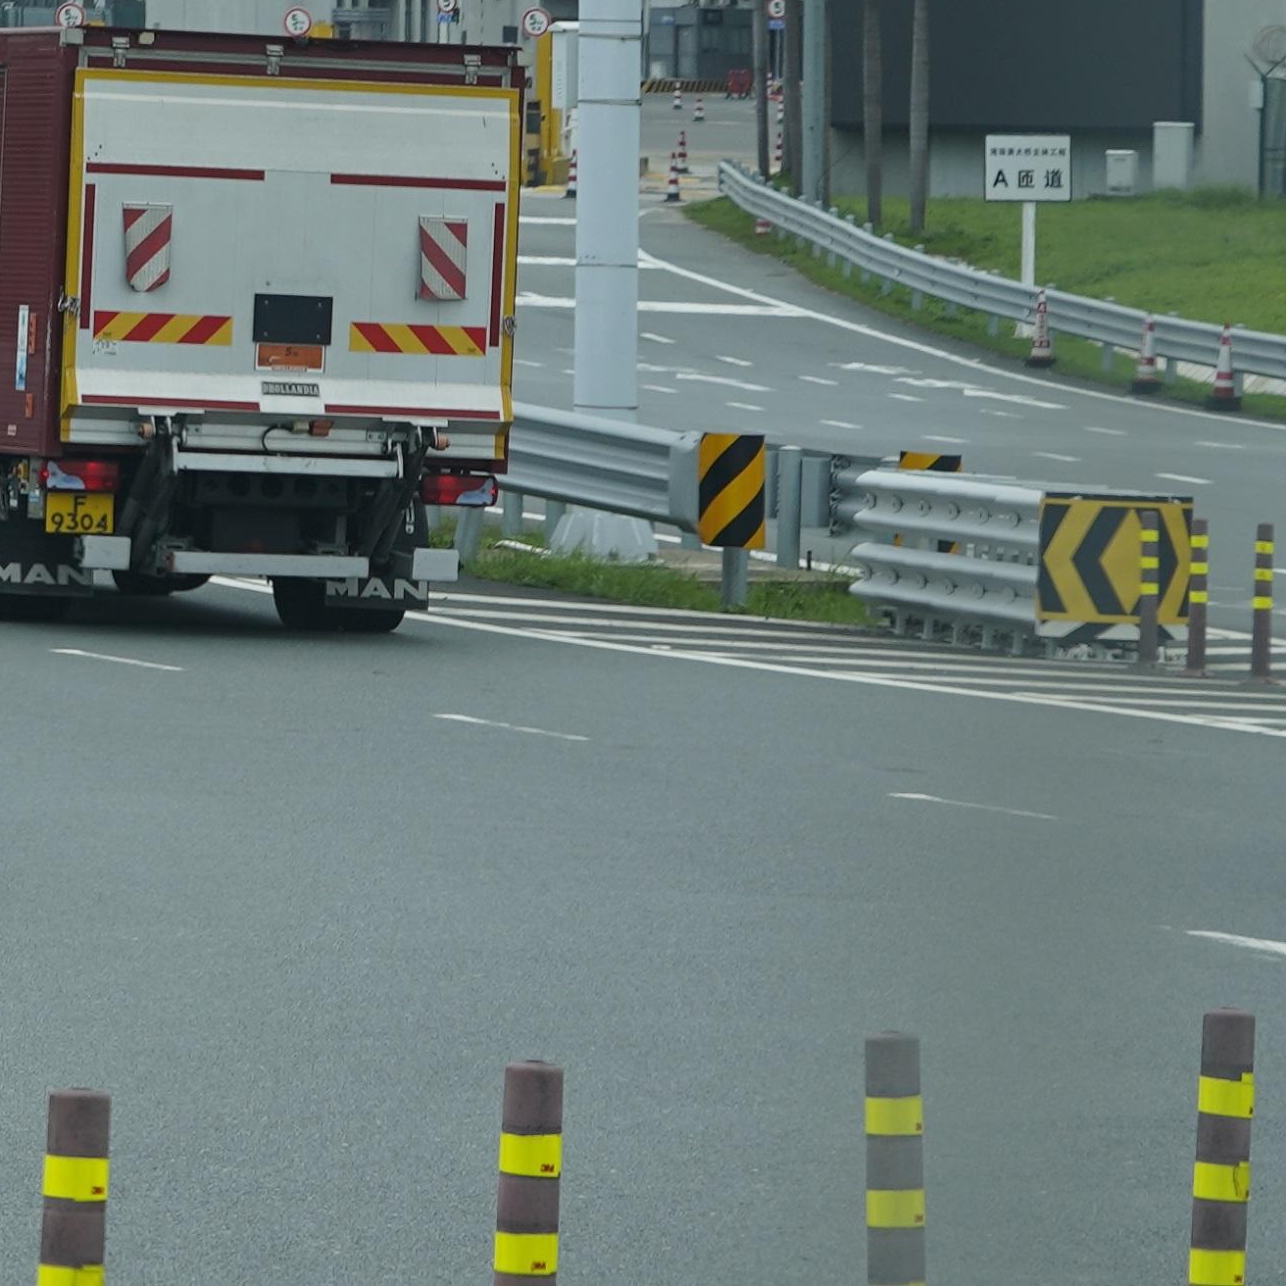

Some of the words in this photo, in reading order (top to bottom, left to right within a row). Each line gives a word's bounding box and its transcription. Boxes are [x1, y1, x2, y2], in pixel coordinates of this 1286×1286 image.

[73, 495, 86, 513] F
[51, 512, 109, 533] 9304
[326, 577, 428, 601] MAN
